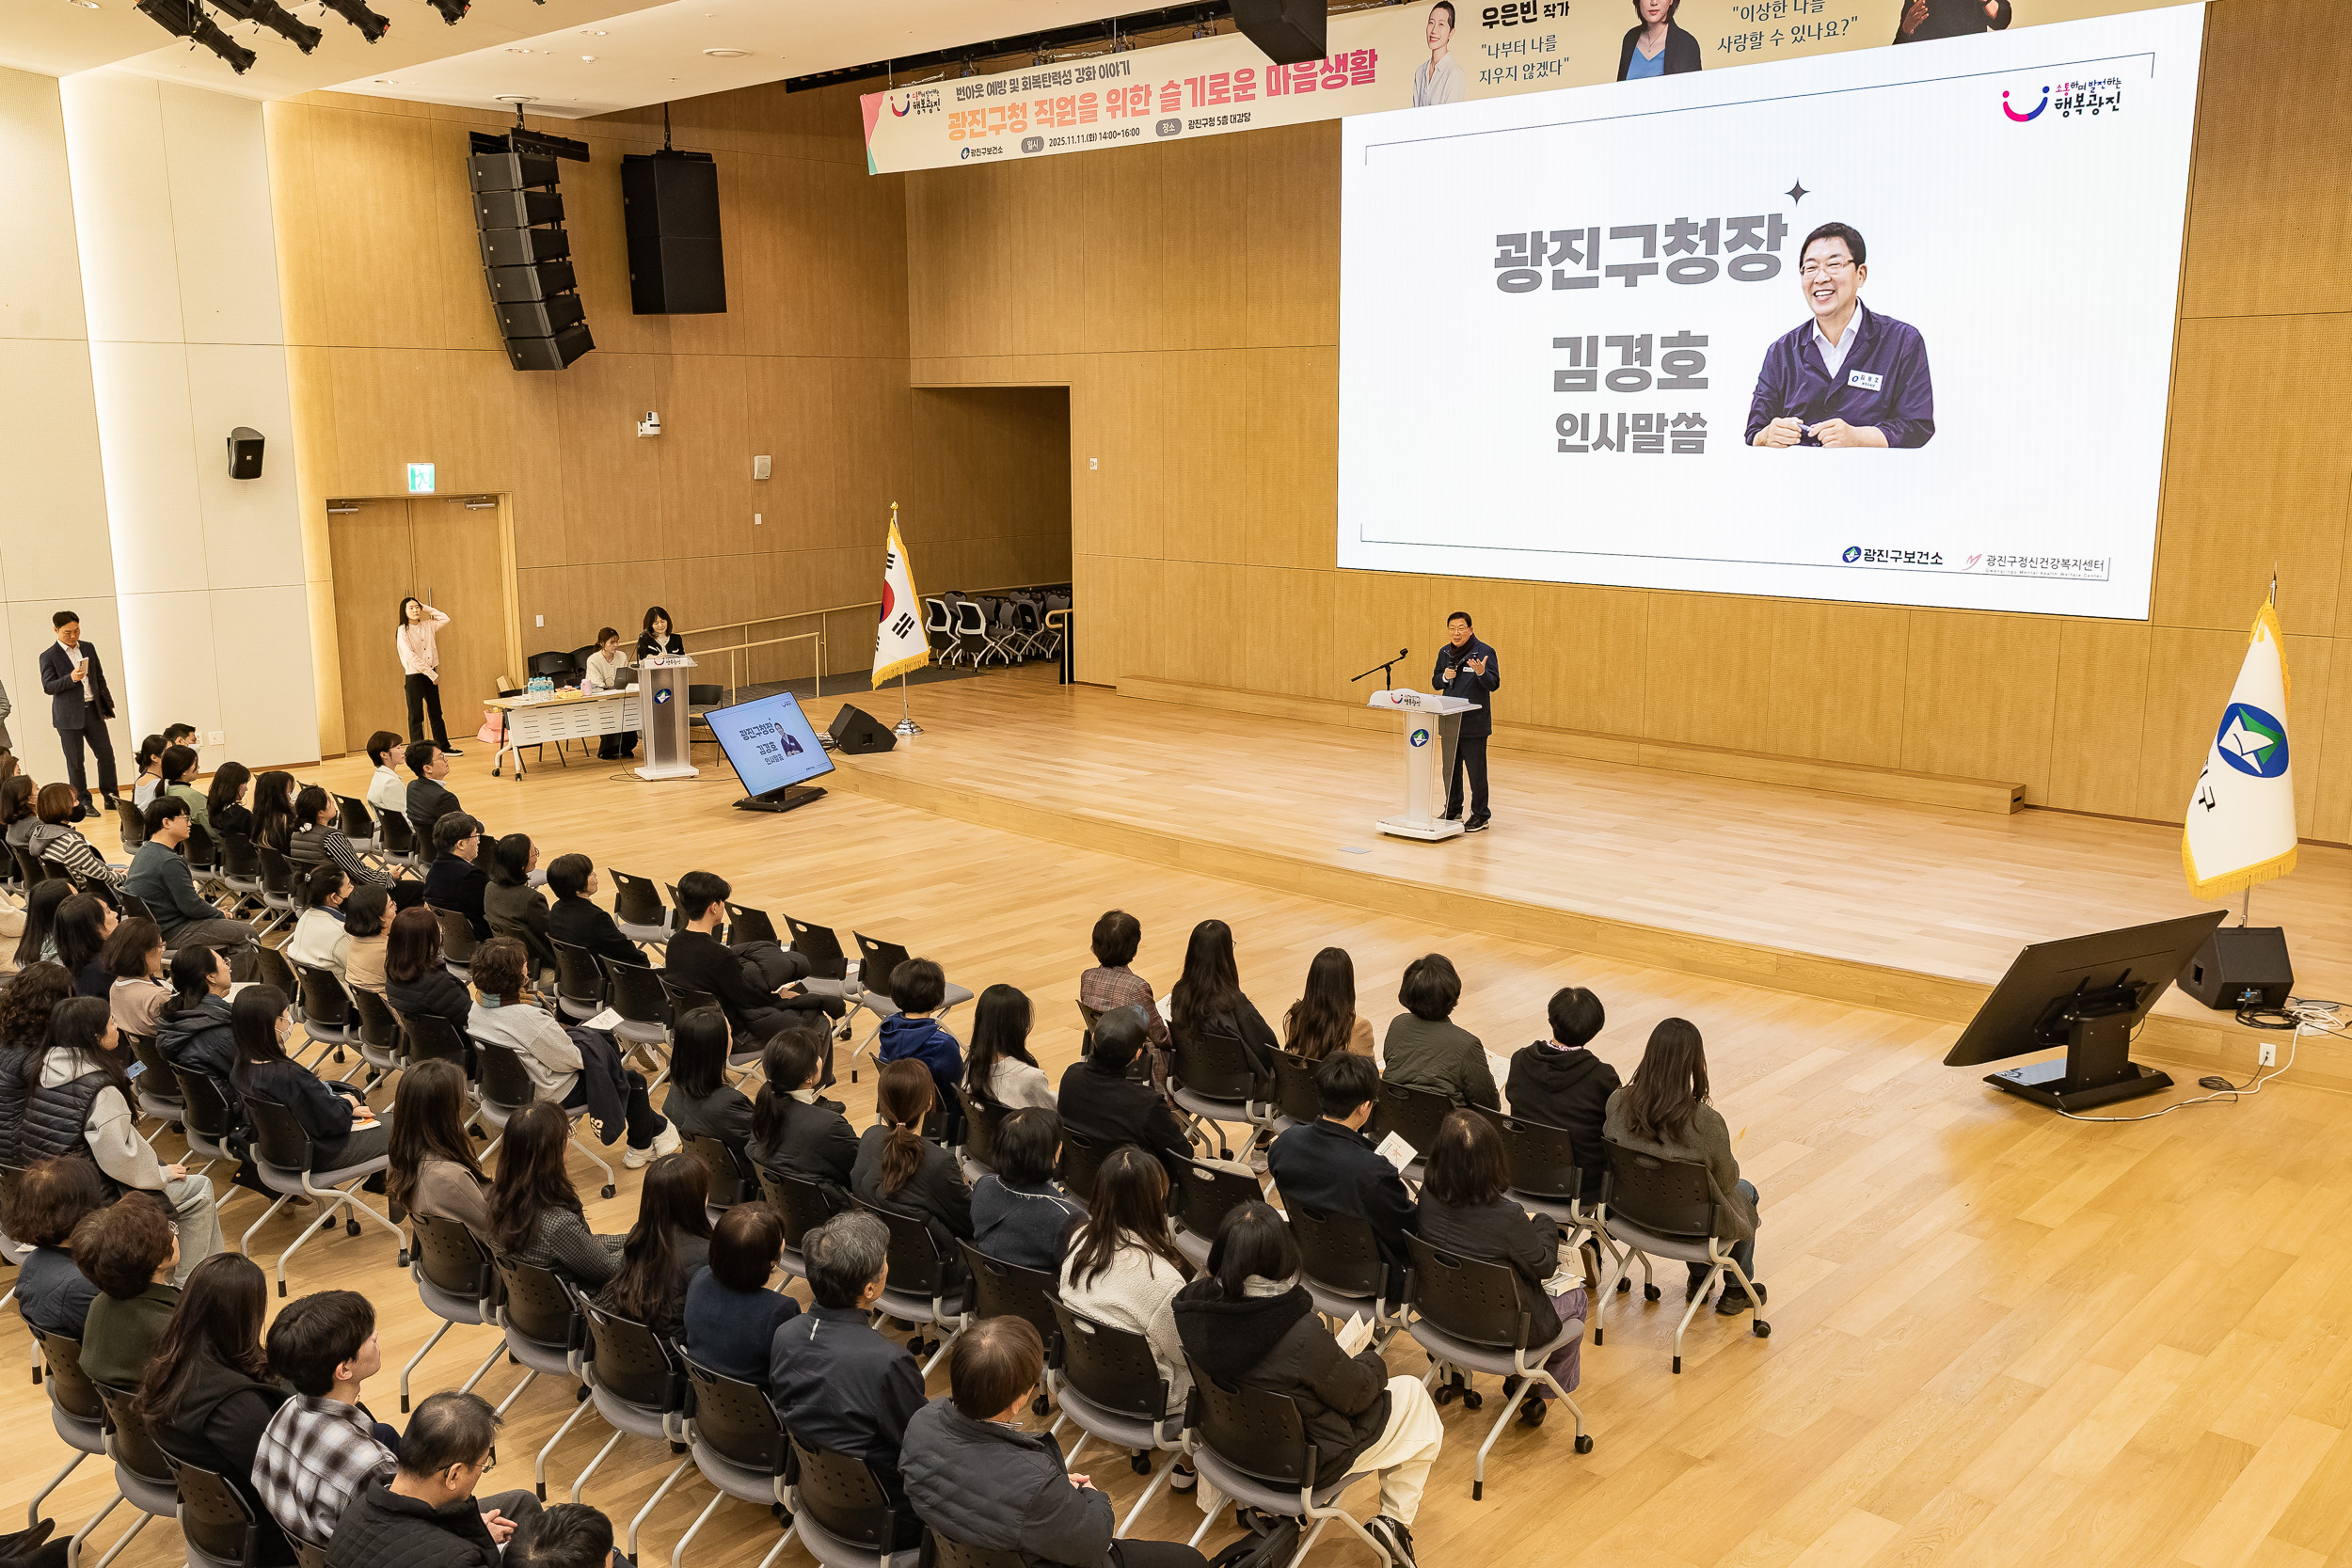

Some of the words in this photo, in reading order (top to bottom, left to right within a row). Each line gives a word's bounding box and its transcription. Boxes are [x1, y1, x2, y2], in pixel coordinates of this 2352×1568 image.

[1482, 0, 1538, 29] 우은빈
[1543, 1, 1570, 19] 작가
[1732, 0, 1788, 23] "이상한
[1481, 39, 1526, 59] "나부터
[1531, 34, 1558, 53] 나를
[1717, 31, 1765, 53] 사랑할
[1769, 29, 1786, 47] 수
[1791, 16, 1858, 44] 있나요?"
[956, 83, 984, 102] 번아웃
[987, 79, 1008, 96] 예방
[1009, 77, 1020, 94] 및
[1021, 69, 1073, 91] 회복탄력성
[1074, 65, 1097, 84] 강화
[1098, 59, 1131, 80] 이야기
[1479, 65, 1518, 85] 지우지
[1522, 56, 1570, 80] 않겠다"
[948, 102, 1028, 141] 광진구청
[1035, 92, 1099, 128] 직원을
[1105, 84, 1152, 119] 위한
[1159, 68, 1257, 113] 슬기로운
[1266, 49, 1378, 97] 마음생활
[2055, 81, 2087, 96] 소통하며
[2088, 77, 2122, 93] 발전하는
[913, 98, 941, 115] 행복광진
[2054, 91, 2122, 118] 행복광진
[1099, 127, 1140, 141] 14:00~16:00
[1162, 122, 1176, 134] 장소
[1187, 118, 1216, 130] 광진구청
[1216, 115, 1229, 126] 5층
[1230, 112, 1251, 124] 대강당
[970, 146, 1004, 157] 광진구보건소
[1494, 213, 1788, 293] 광진구청장
[1552, 330, 1709, 393] 김경호
[1554, 412, 1708, 454] 인사말씀
[1863, 548, 1944, 565] 광진구보건소
[1986, 554, 2105, 572] 광진구정신건강복지센터
[739, 721, 775, 741] 광진구청장
